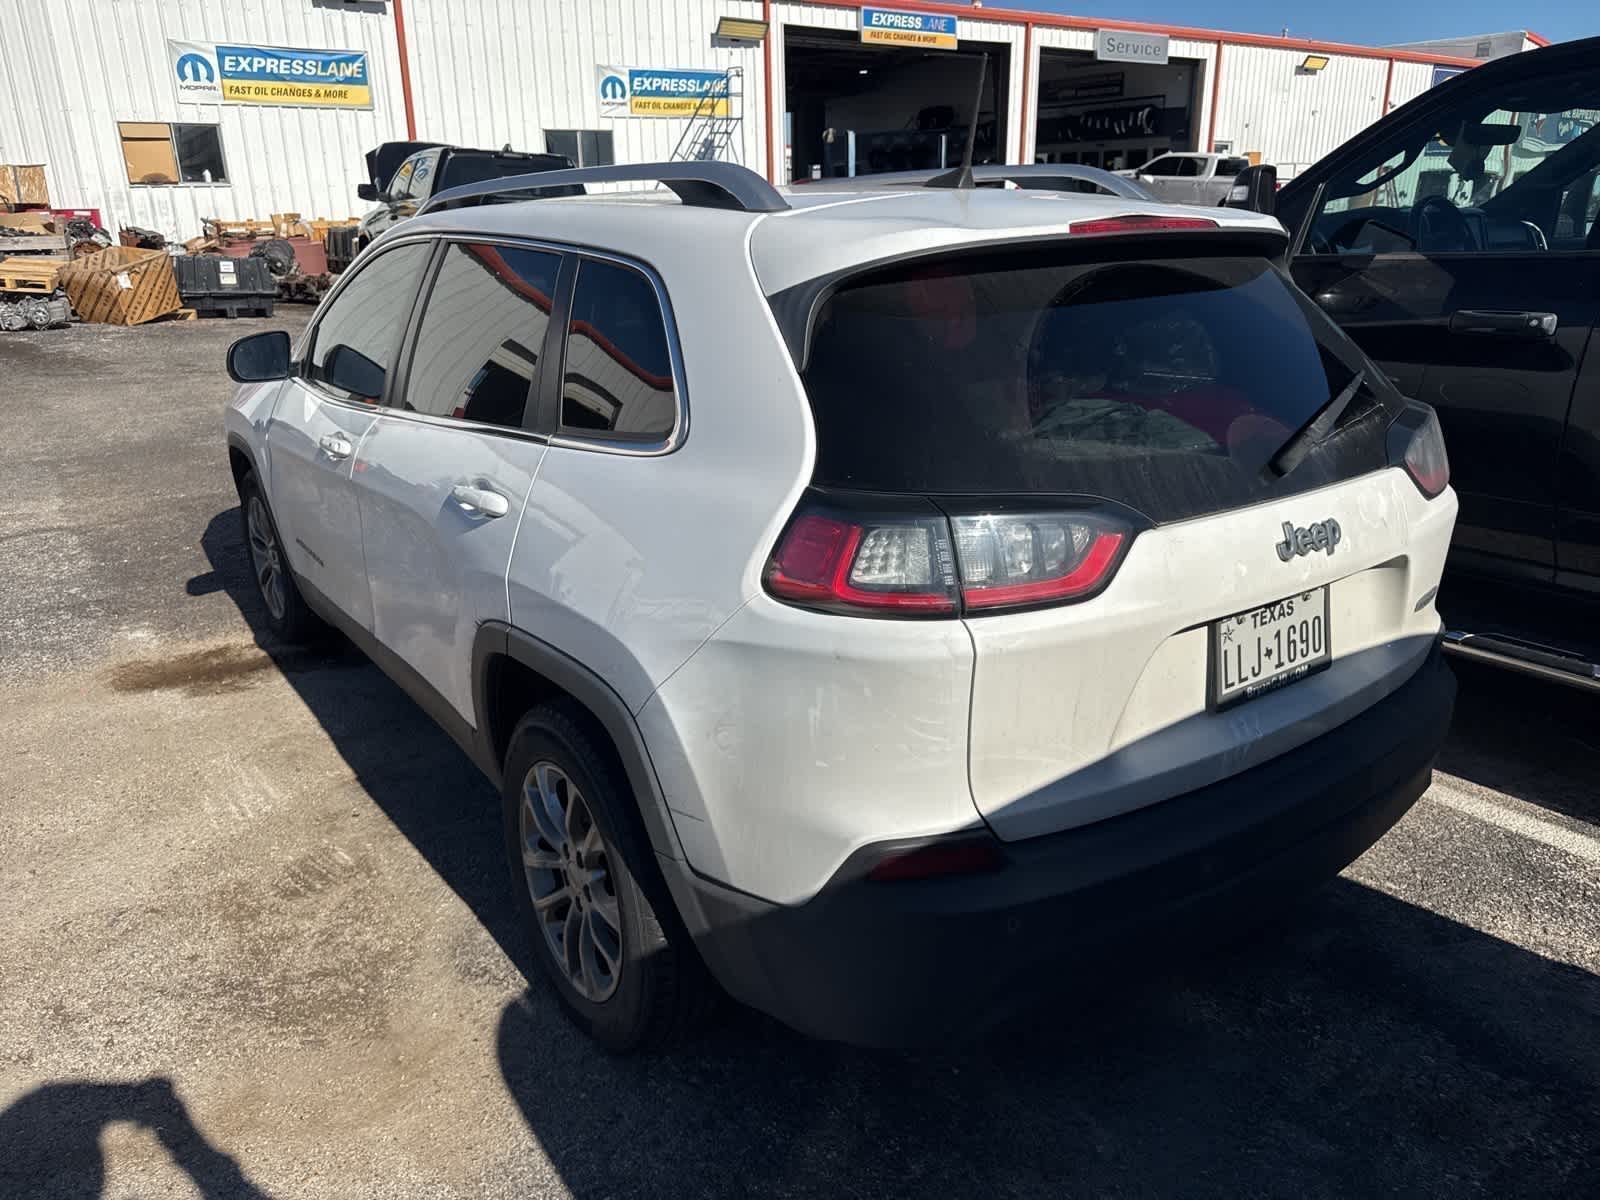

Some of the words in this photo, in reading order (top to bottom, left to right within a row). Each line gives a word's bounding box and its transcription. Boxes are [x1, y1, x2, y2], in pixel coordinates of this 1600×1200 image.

[1106, 37, 1161, 56] Service
[223, 55, 363, 79] EXPRESSLANE
[229, 86, 252, 96] FAST
[254, 86, 268, 96] OIL
[271, 87, 313, 98] CHANGES
[315, 89, 322, 98] &
[323, 89, 349, 99] MORE
[634, 101, 651, 110] FAST
[651, 102, 661, 110] OIL
[663, 102, 691, 110] CHANGES
[1275, 517, 1342, 562] Jeep
[1250, 600, 1295, 629] TEXAS
